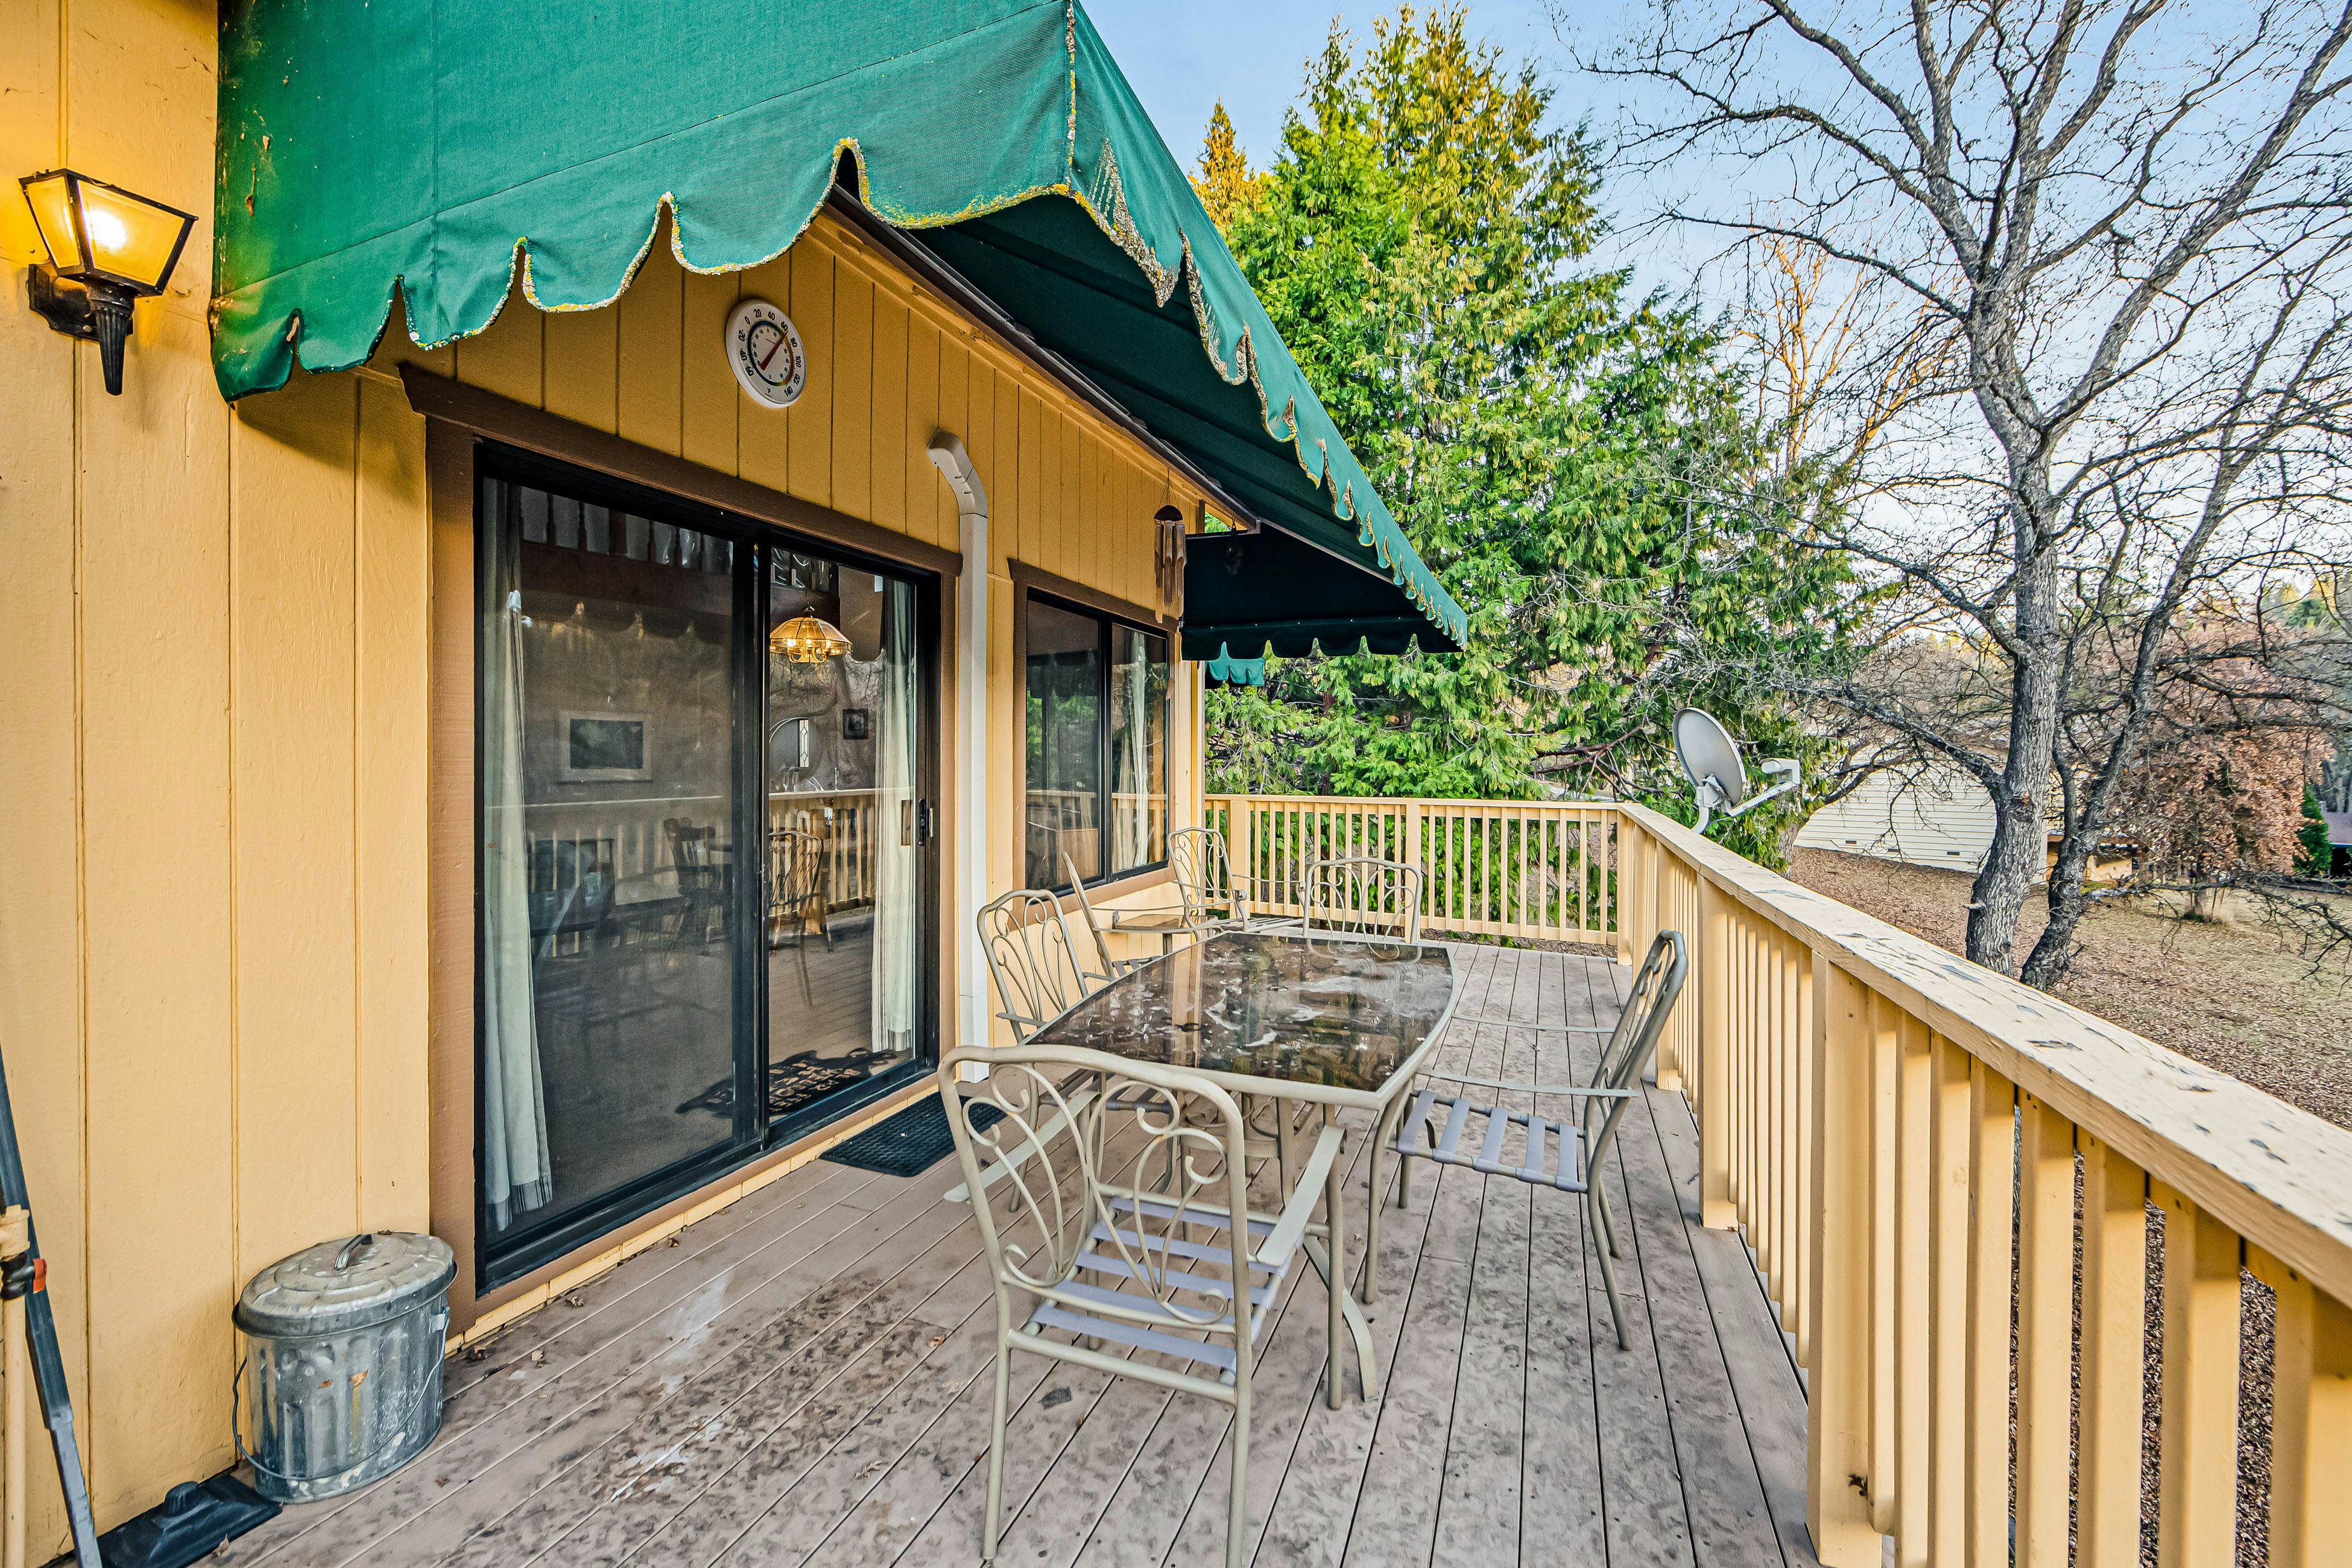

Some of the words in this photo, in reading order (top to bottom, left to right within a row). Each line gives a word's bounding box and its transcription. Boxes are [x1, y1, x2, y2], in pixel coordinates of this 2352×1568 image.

[754, 308, 762, 318] 20
[768, 311, 775, 321] 40
[744, 315, 751, 324] 0
[780, 321, 788, 332] 60
[790, 337, 797, 348] 80
[784, 385, 793, 397] 140
